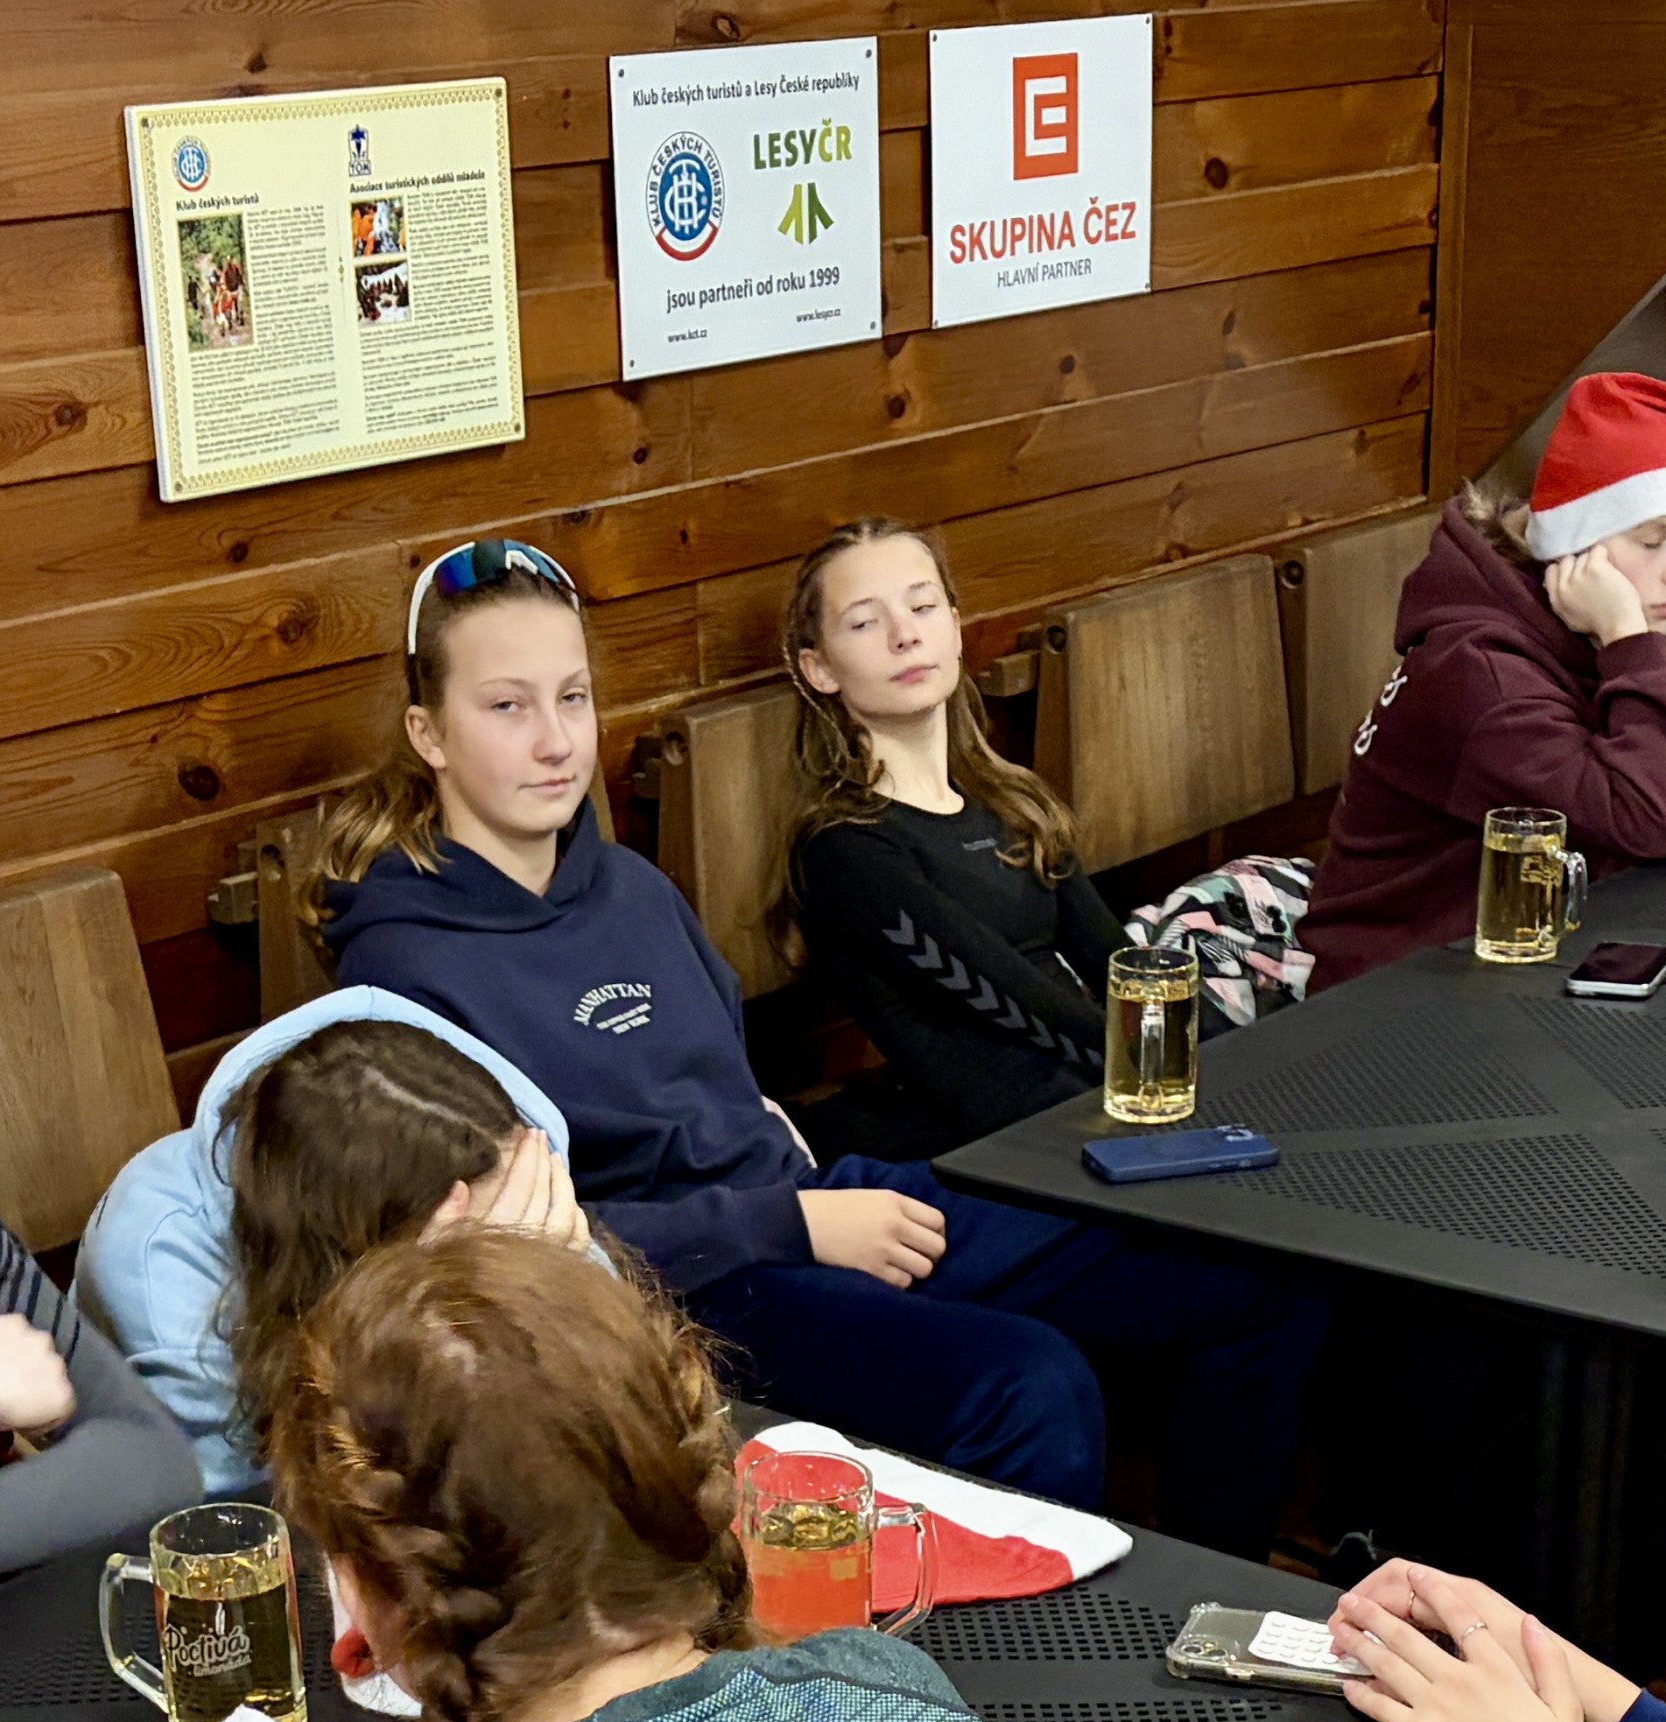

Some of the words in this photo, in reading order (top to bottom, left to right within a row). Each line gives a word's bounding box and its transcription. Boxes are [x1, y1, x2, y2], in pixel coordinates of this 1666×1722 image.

[633, 89, 659, 106] Klub
[661, 84, 704, 106] českých
[706, 80, 743, 99] turistů
[745, 83, 752, 97] a
[754, 80, 777, 98] Lesy
[779, 73, 810, 93] České
[812, 71, 860, 94] republiky
[652, 132, 703, 177] ČESKÝCH
[753, 117, 853, 170] LESYČR
[176, 199, 197, 211] Klub
[198, 195, 231, 209] českých
[349, 182, 383, 193] Asociace
[385, 176, 430, 191] turistických
[648, 180, 662, 228] KLUB
[703, 149, 723, 220] TURISTŮ
[949, 210, 1076, 264] SKUPINA
[1083, 196, 1137, 245] ČEZ
[666, 289, 695, 314] jsou
[699, 278, 753, 309] partneři
[756, 274, 773, 296] od
[777, 271, 806, 293] roku
[809, 266, 840, 289] 1999
[997, 262, 1040, 288] HLAVNÍ
[1042, 258, 1092, 281] PARTNER
[573, 982, 652, 1027] MANHATTAN
